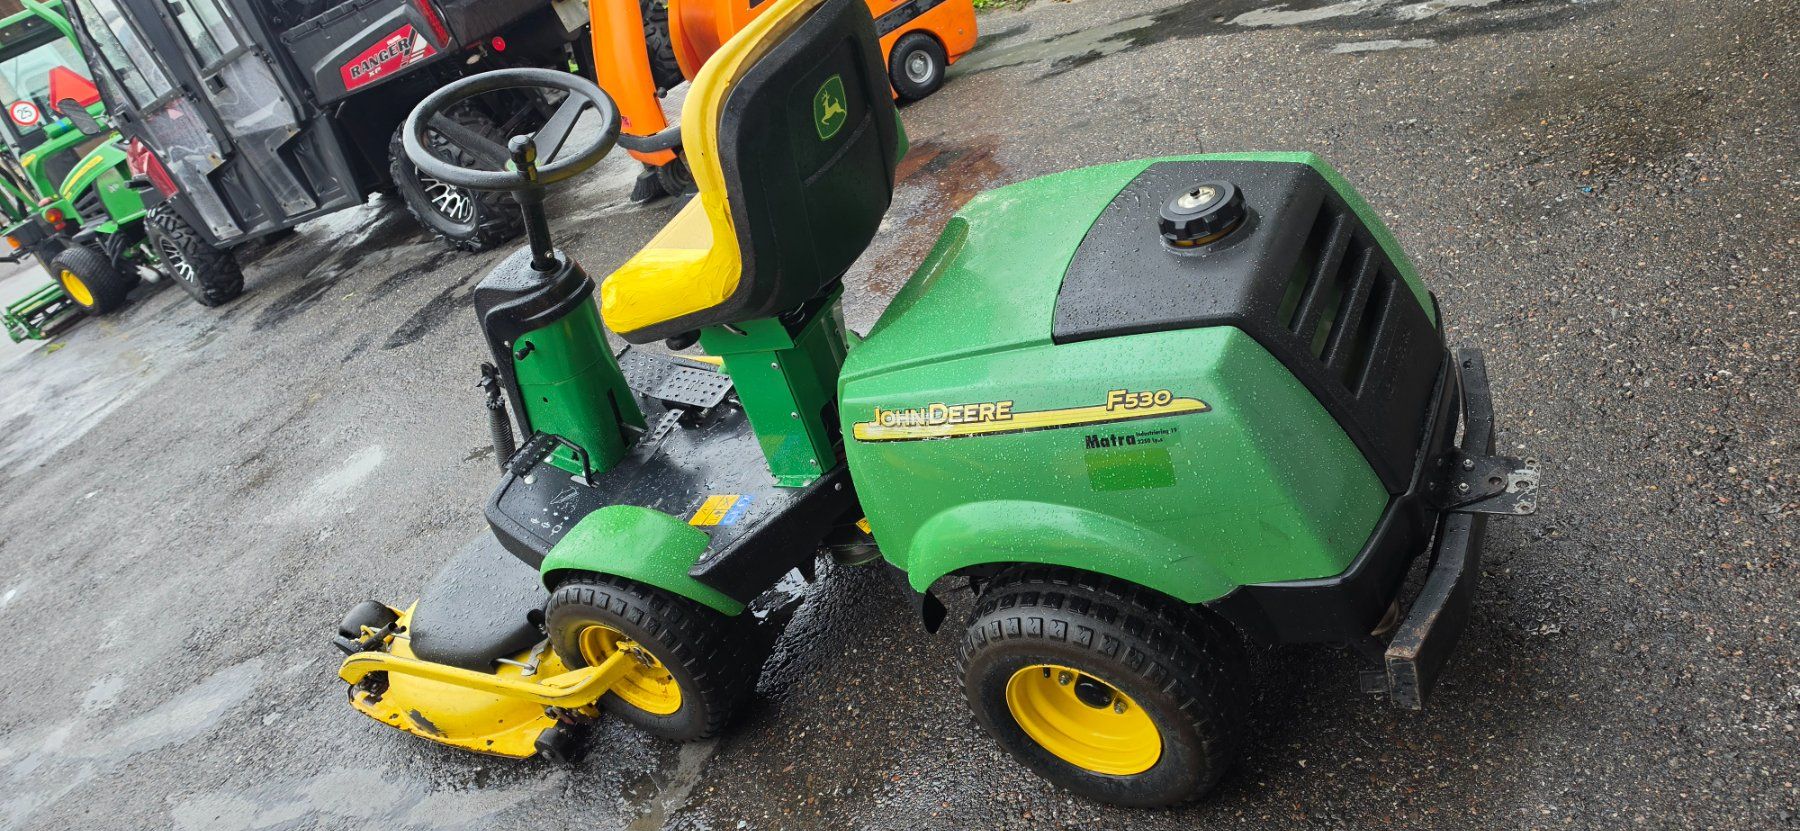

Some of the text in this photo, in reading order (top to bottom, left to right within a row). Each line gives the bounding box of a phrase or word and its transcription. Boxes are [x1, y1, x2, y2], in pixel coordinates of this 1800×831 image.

[350, 37, 410, 79] RANGER
[368, 66, 382, 77] XP
[16, 106, 33, 120] 25
[1106, 389, 1173, 411] F530
[870, 400, 1014, 427] JOHN DEERE
[1085, 433, 1136, 449] Matra
